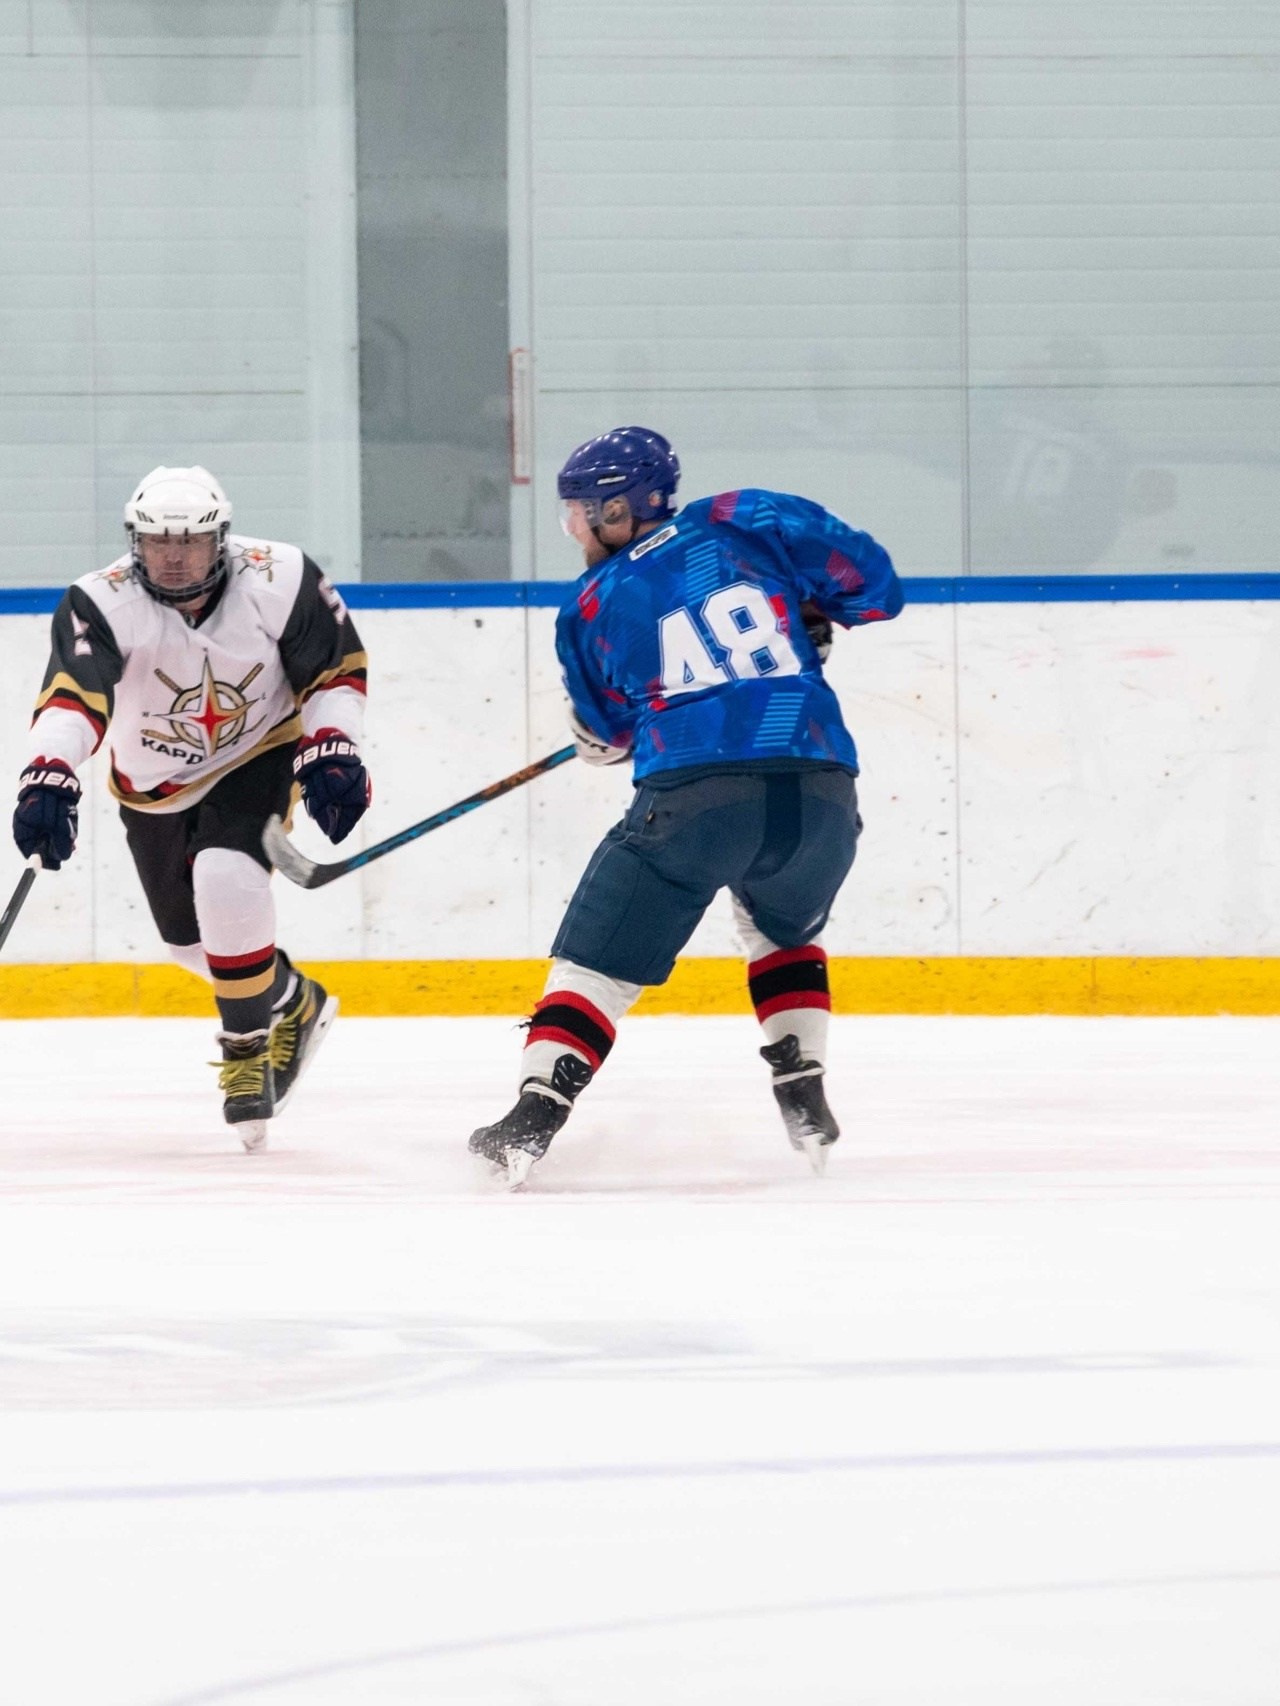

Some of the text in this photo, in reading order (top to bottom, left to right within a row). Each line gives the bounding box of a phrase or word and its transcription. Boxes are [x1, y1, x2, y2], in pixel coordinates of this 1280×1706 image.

[657, 580, 802, 699] 48
[141, 737, 204, 765] КАРД
[19, 770, 79, 792] AUER
